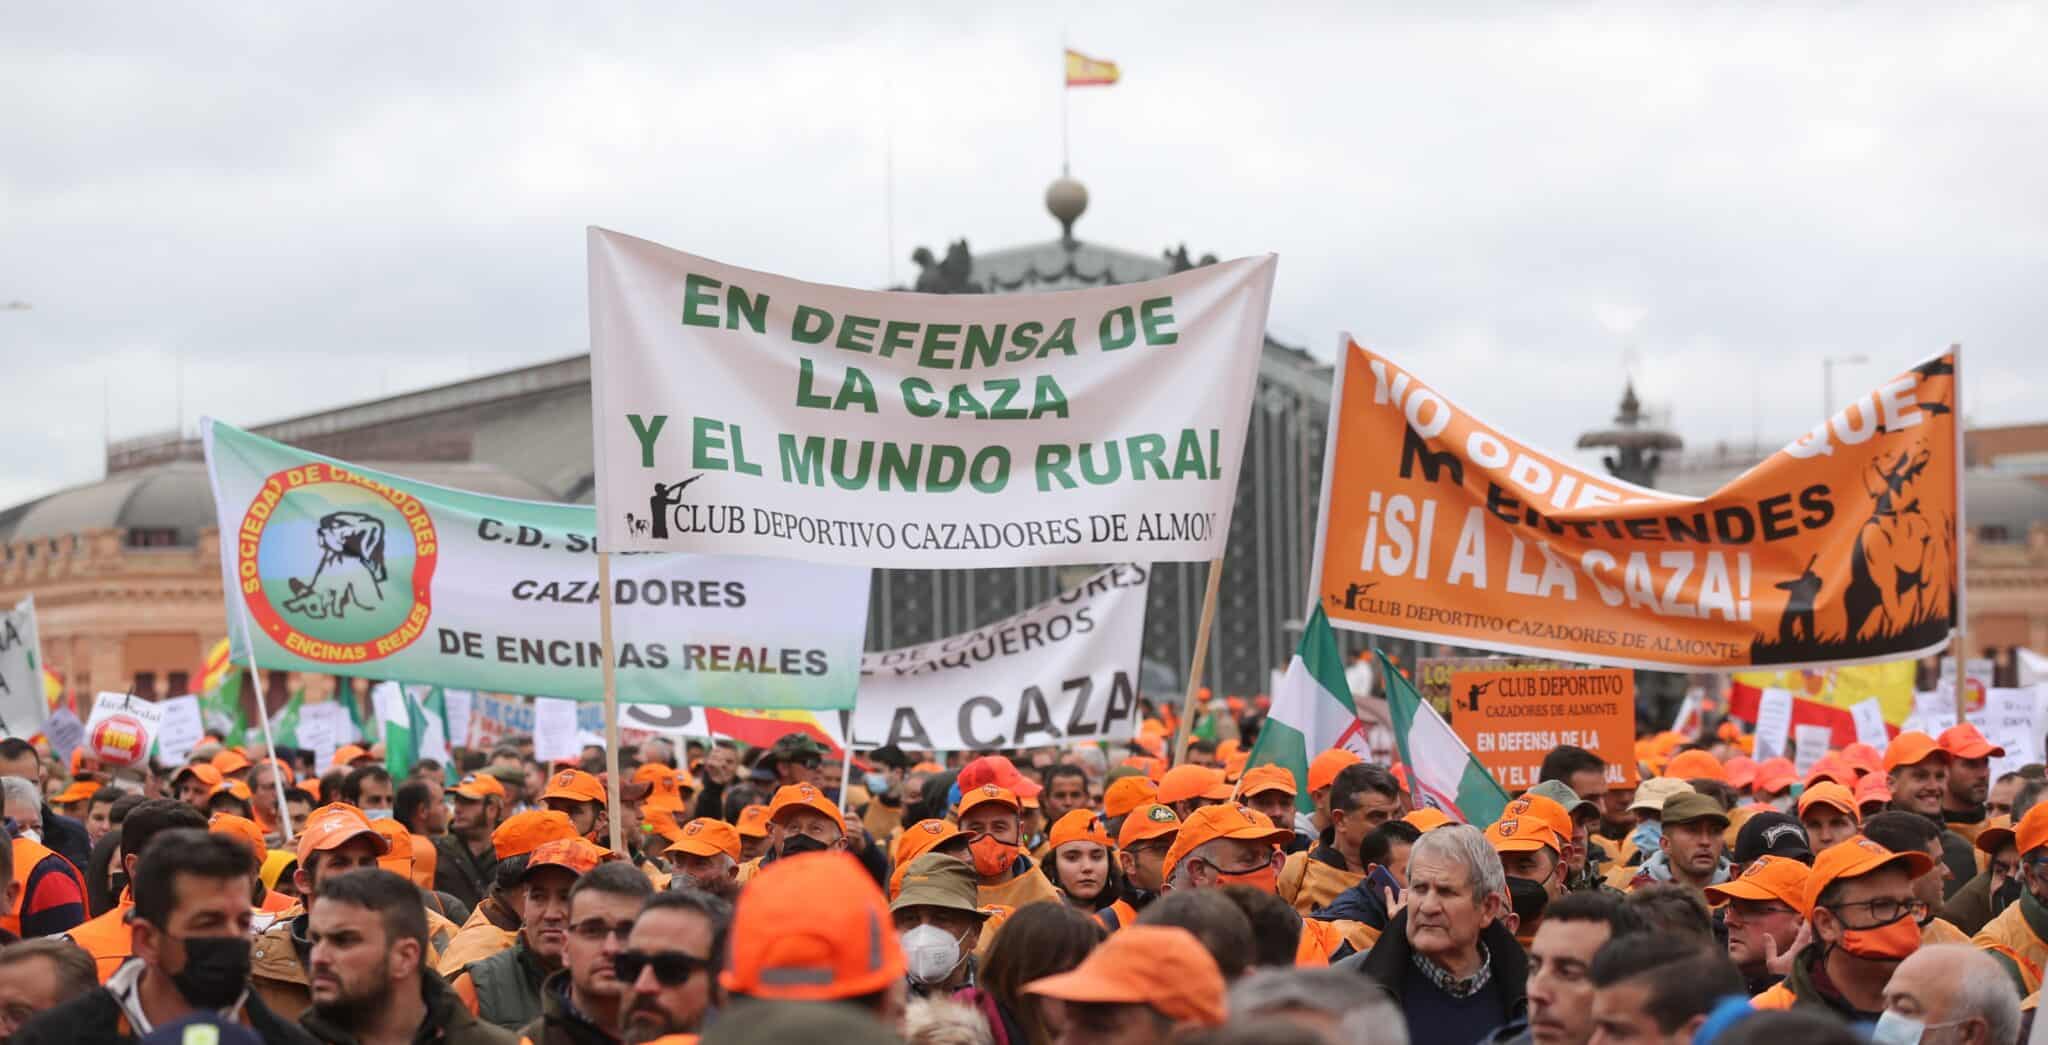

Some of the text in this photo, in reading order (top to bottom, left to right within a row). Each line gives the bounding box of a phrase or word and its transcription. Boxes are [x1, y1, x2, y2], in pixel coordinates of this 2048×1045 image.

[682, 273, 1179, 370] EN DEFENSA DE
[796, 357, 1070, 419] LA CAZA
[626, 414, 668, 468] Y
[692, 416, 763, 477] EL
[778, 433, 1011, 494] MUNDO
[1370, 360, 1924, 511] NO ODIE QUE
[287, 465, 321, 486] DE
[477, 517, 551, 549] C.D.
[674, 504, 746, 534] CLUB
[753, 508, 896, 549] DEPORTIVO
[901, 516, 1082, 550] CAZADORES
[1089, 514, 1129, 543] DE
[1360, 490, 1753, 622] ¡SI A LA CAZA!
[284, 602, 429, 661] ENCINAS REALES
[438, 628, 484, 659] DE
[683, 644, 829, 676] REALES
[1358, 597, 1741, 659] CLUB DEPORTIVO CAZADORES DE ALMONTE
[957, 671, 1134, 751] CAZA
[1485, 702, 1619, 718] CAZADORES DE ALMONTE
[1498, 675, 1624, 698] CLUB DEPORTIVO
[1477, 729, 1600, 752] EN DEFENSA DE LA
[1497, 766, 1507, 785] Y
[1510, 766, 1527, 785] EL
